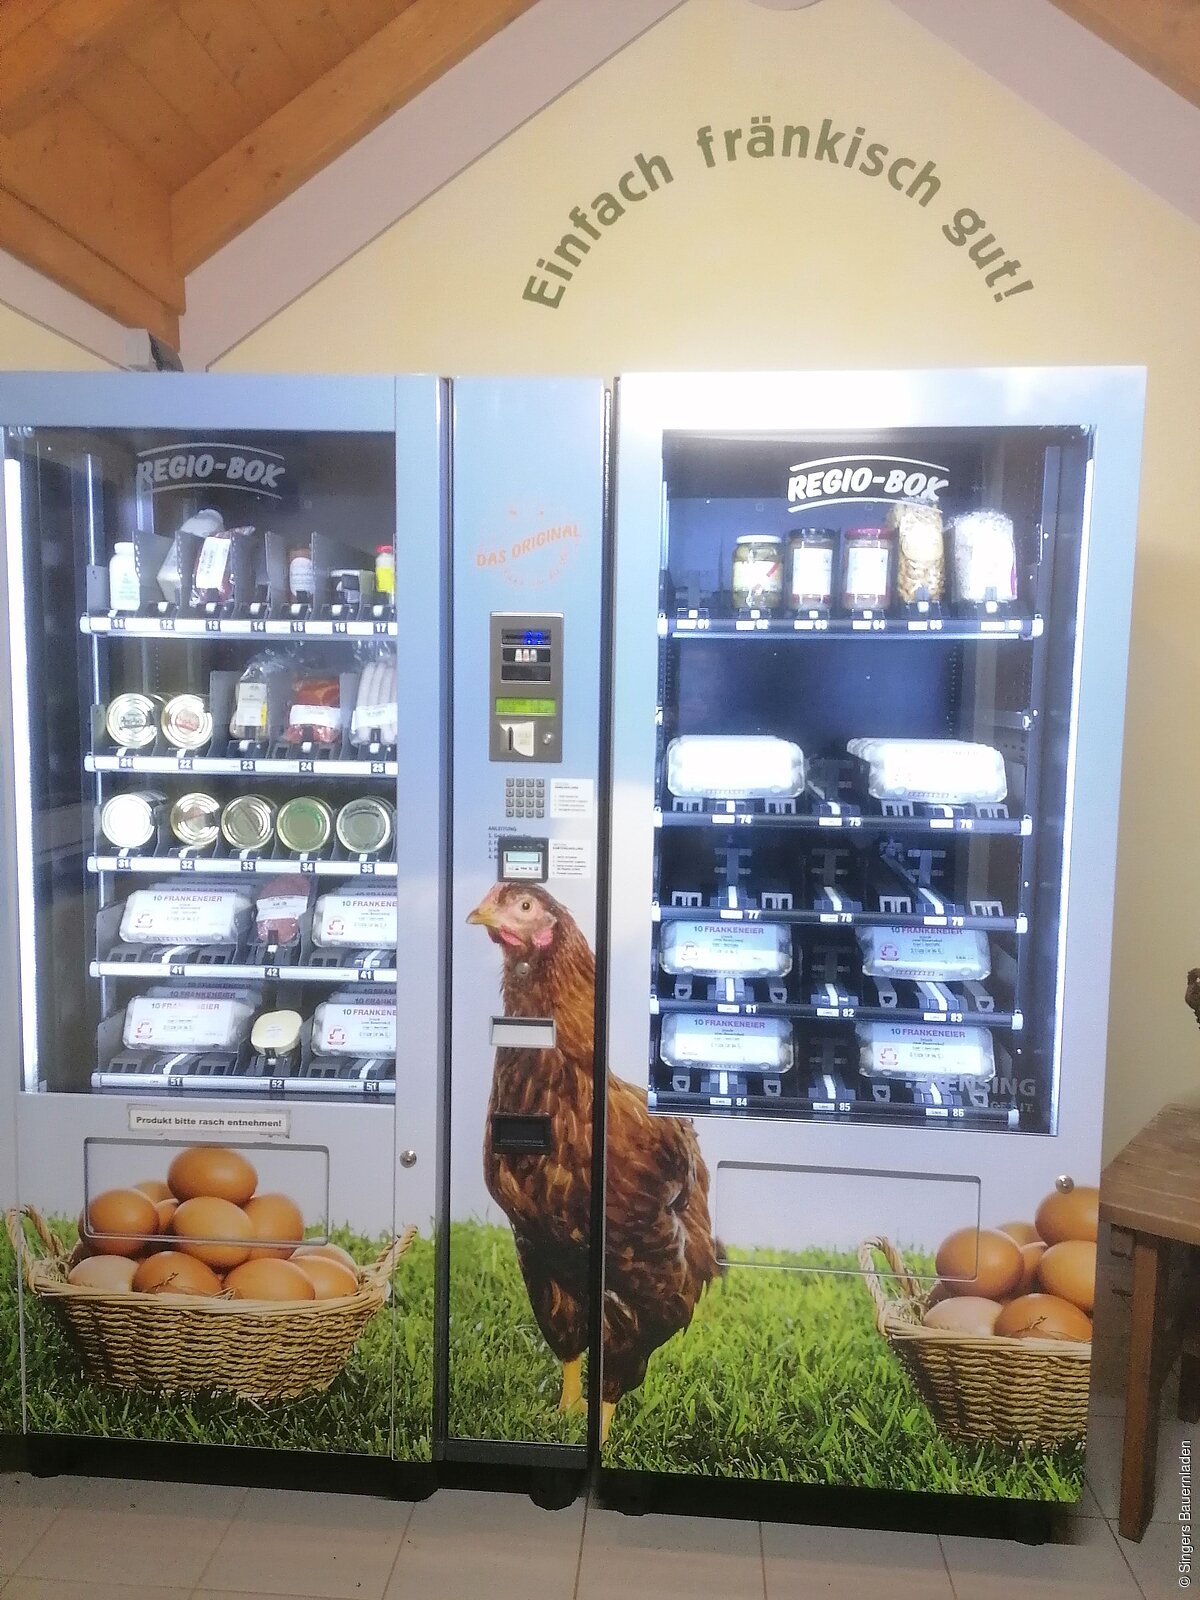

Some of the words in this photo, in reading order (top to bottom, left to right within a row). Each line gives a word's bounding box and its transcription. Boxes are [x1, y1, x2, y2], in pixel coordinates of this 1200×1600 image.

[522, 152, 674, 309] Einfach
[696, 116, 942, 208] fränkisch
[942, 207, 1034, 303] gut!
[136, 454, 286, 488] REGIO-BOX
[788, 467, 949, 502] REGIO-BOX
[476, 549, 507, 568] DAS
[511, 524, 581, 558] ORIGINAL
[206, 620, 220, 631] 13
[252, 621, 264, 632] 14
[242, 760, 254, 772] 23
[300, 762, 313, 772] 24
[372, 762, 384, 774] 25
[739, 814, 753, 826] 74
[848, 816, 862, 828] 75
[181, 860, 194, 870] 32
[242, 861, 255, 872] 33
[301, 862, 314, 872] 34
[361, 862, 374, 873] 35
[747, 910, 760, 920] 77
[694, 925, 703, 933] 10
[704, 925, 765, 934] FRANKENEIER
[266, 967, 278, 977] 42
[343, 1008, 352, 1016] 10
[744, 1004, 758, 1014] 81
[842, 1008, 855, 1018] 82
[950, 1012, 963, 1023] 83
[694, 1018, 704, 1028] 10
[704, 1019, 766, 1029] FRANKENEIER
[890, 1027, 901, 1036] 10
[902, 1028, 966, 1038] FRANKENEIER
[170, 1077, 182, 1087] 51
[270, 1079, 284, 1089] 52
[735, 1096, 748, 1107] 84
[838, 1102, 852, 1112] 85
[136, 1116, 172, 1125] Produkt
[174, 1117, 196, 1126] bitte
[198, 1118, 225, 1126] rasch
[227, 1118, 282, 1128] entnehmen!
